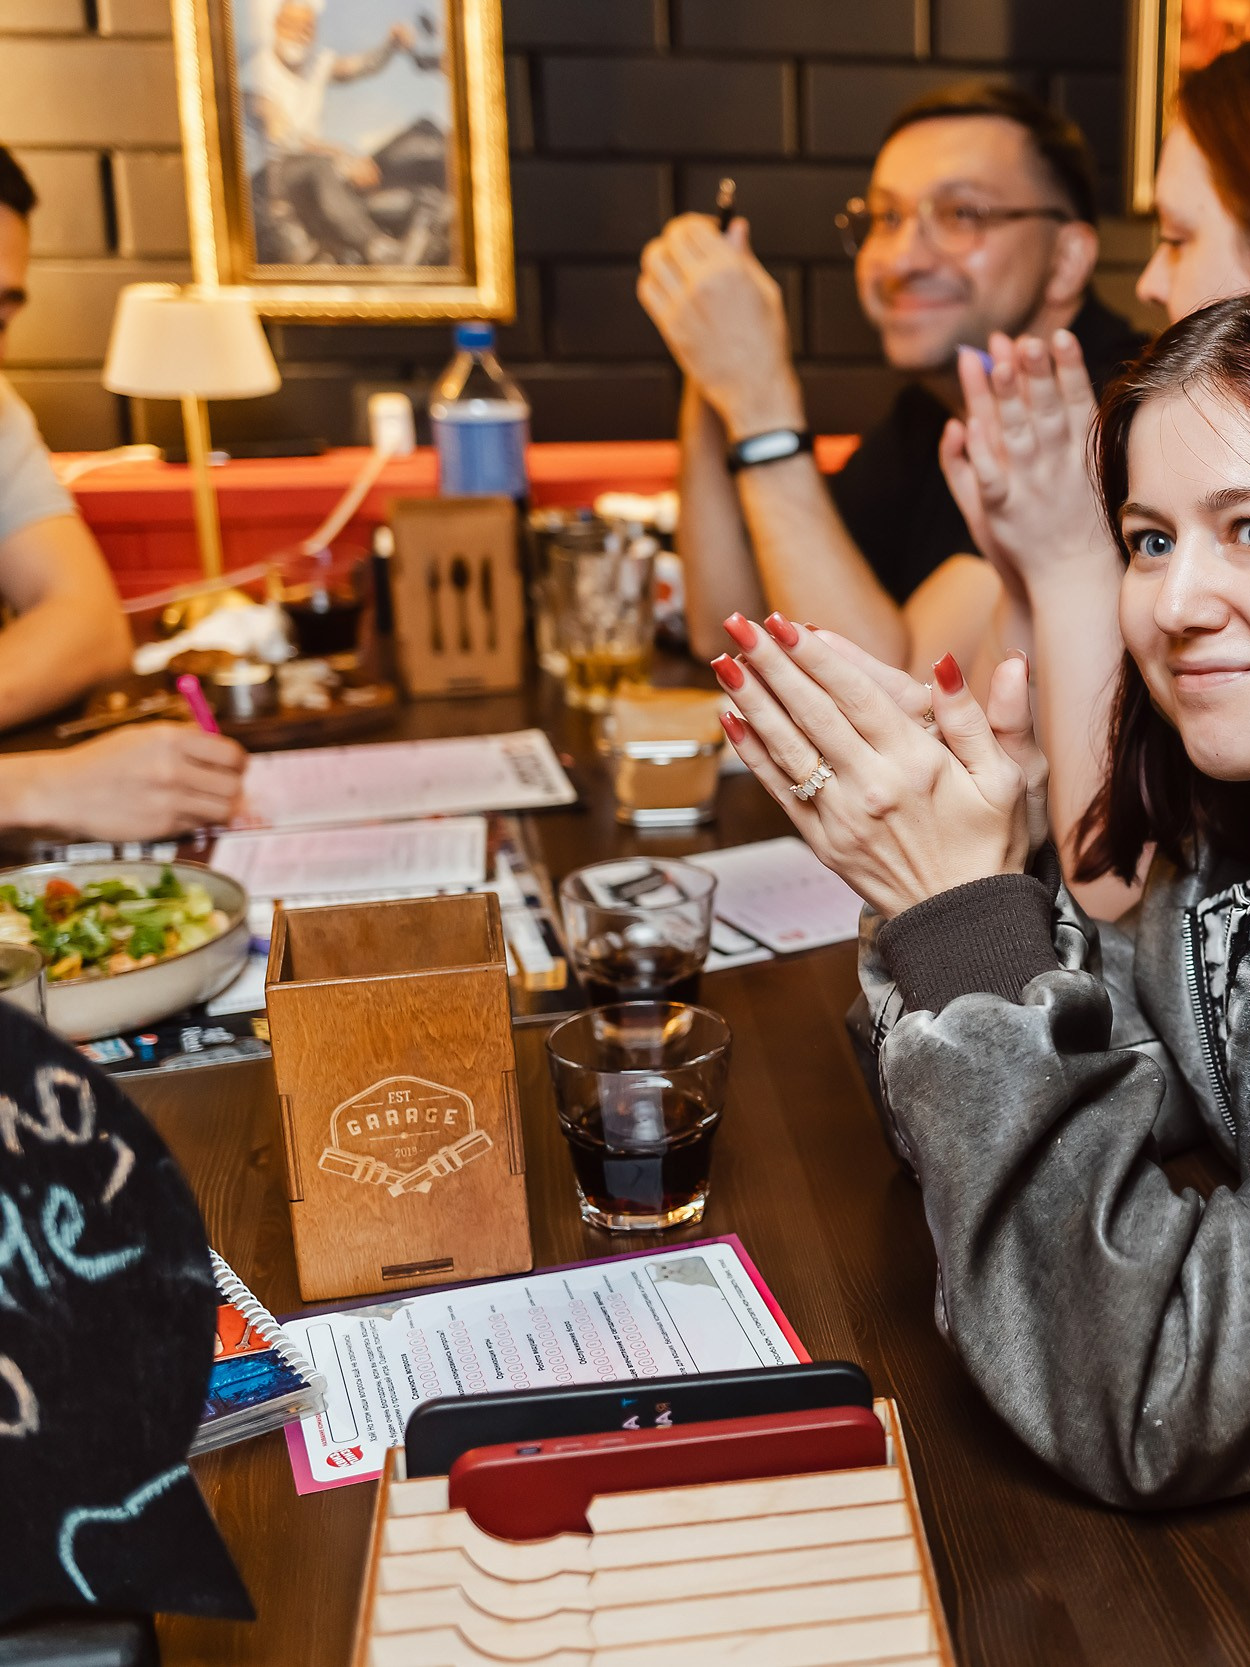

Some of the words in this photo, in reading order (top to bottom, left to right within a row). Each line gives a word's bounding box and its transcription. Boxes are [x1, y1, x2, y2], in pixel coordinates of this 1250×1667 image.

[593, 1291, 604, 1305] вечера
[564, 1321, 573, 1332] бара
[600, 1306, 617, 1334] сегодняшнего
[364, 1338, 374, 1361] поделитесь
[436, 1330, 450, 1350] вопросы?
[485, 1338, 493, 1349] игры
[526, 1334, 539, 1354] ведущего
[569, 1332, 587, 1364] Обслуживание
[616, 1341, 633, 1368] впечатление
[668, 1345, 679, 1358] ваших
[769, 1346, 784, 1366] Спасибо
[401, 1353, 412, 1374] вопросов
[446, 1351, 459, 1379] понравились
[488, 1350, 504, 1379] Организация
[534, 1355, 545, 1371] Работа
[372, 1369, 380, 1379] если
[356, 1378, 366, 1398] вопросы
[384, 1377, 399, 1403] прошедшей
[407, 1375, 419, 1400] Сложность
[384, 1409, 392, 1423] очень
[367, 1423, 374, 1431] На
